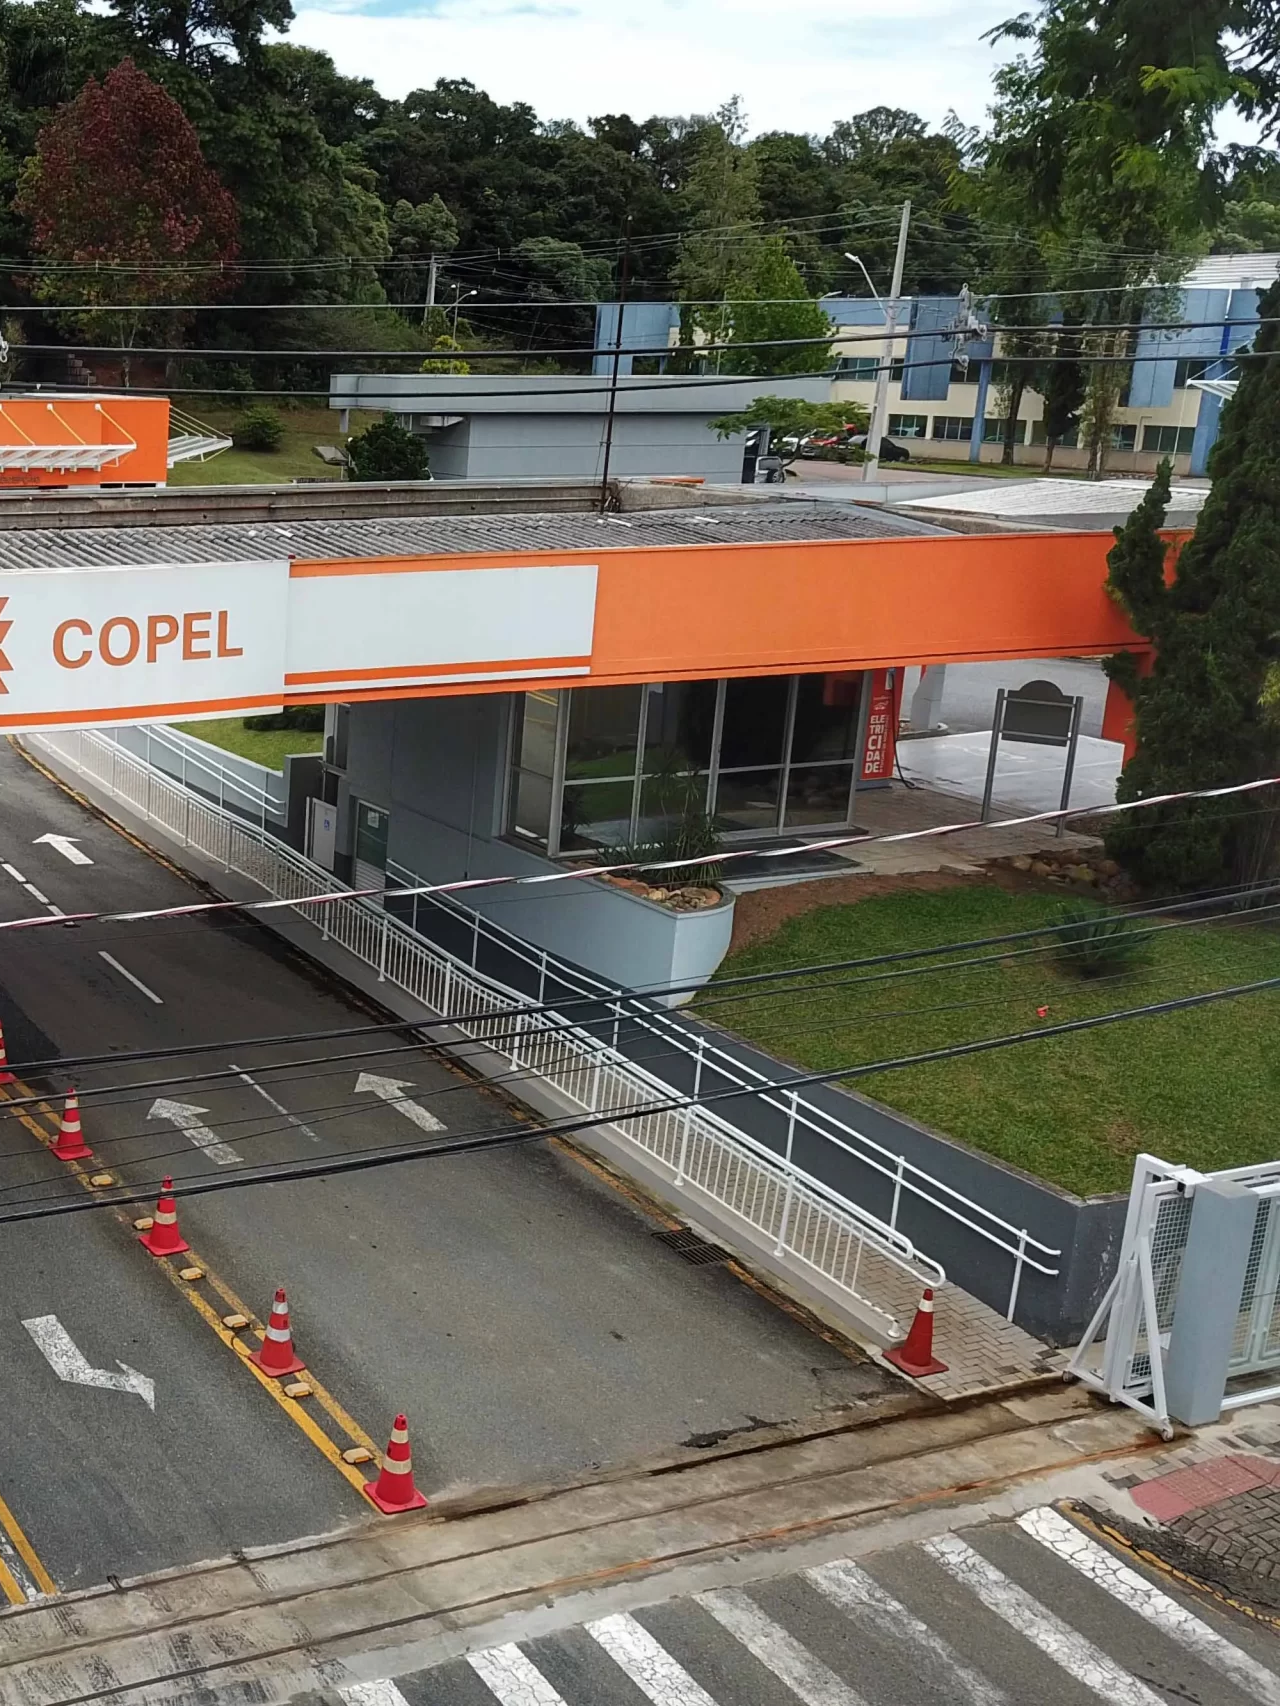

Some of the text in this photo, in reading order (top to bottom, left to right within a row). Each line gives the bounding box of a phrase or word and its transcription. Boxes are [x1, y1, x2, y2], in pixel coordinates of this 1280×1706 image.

[53, 610, 244, 669] COPEL
[870, 715, 885, 724] ELE
[869, 725, 884, 734] TRI
[868, 735, 882, 750] CI
[867, 751, 880, 761] DA
[865, 762, 879, 773] DE
